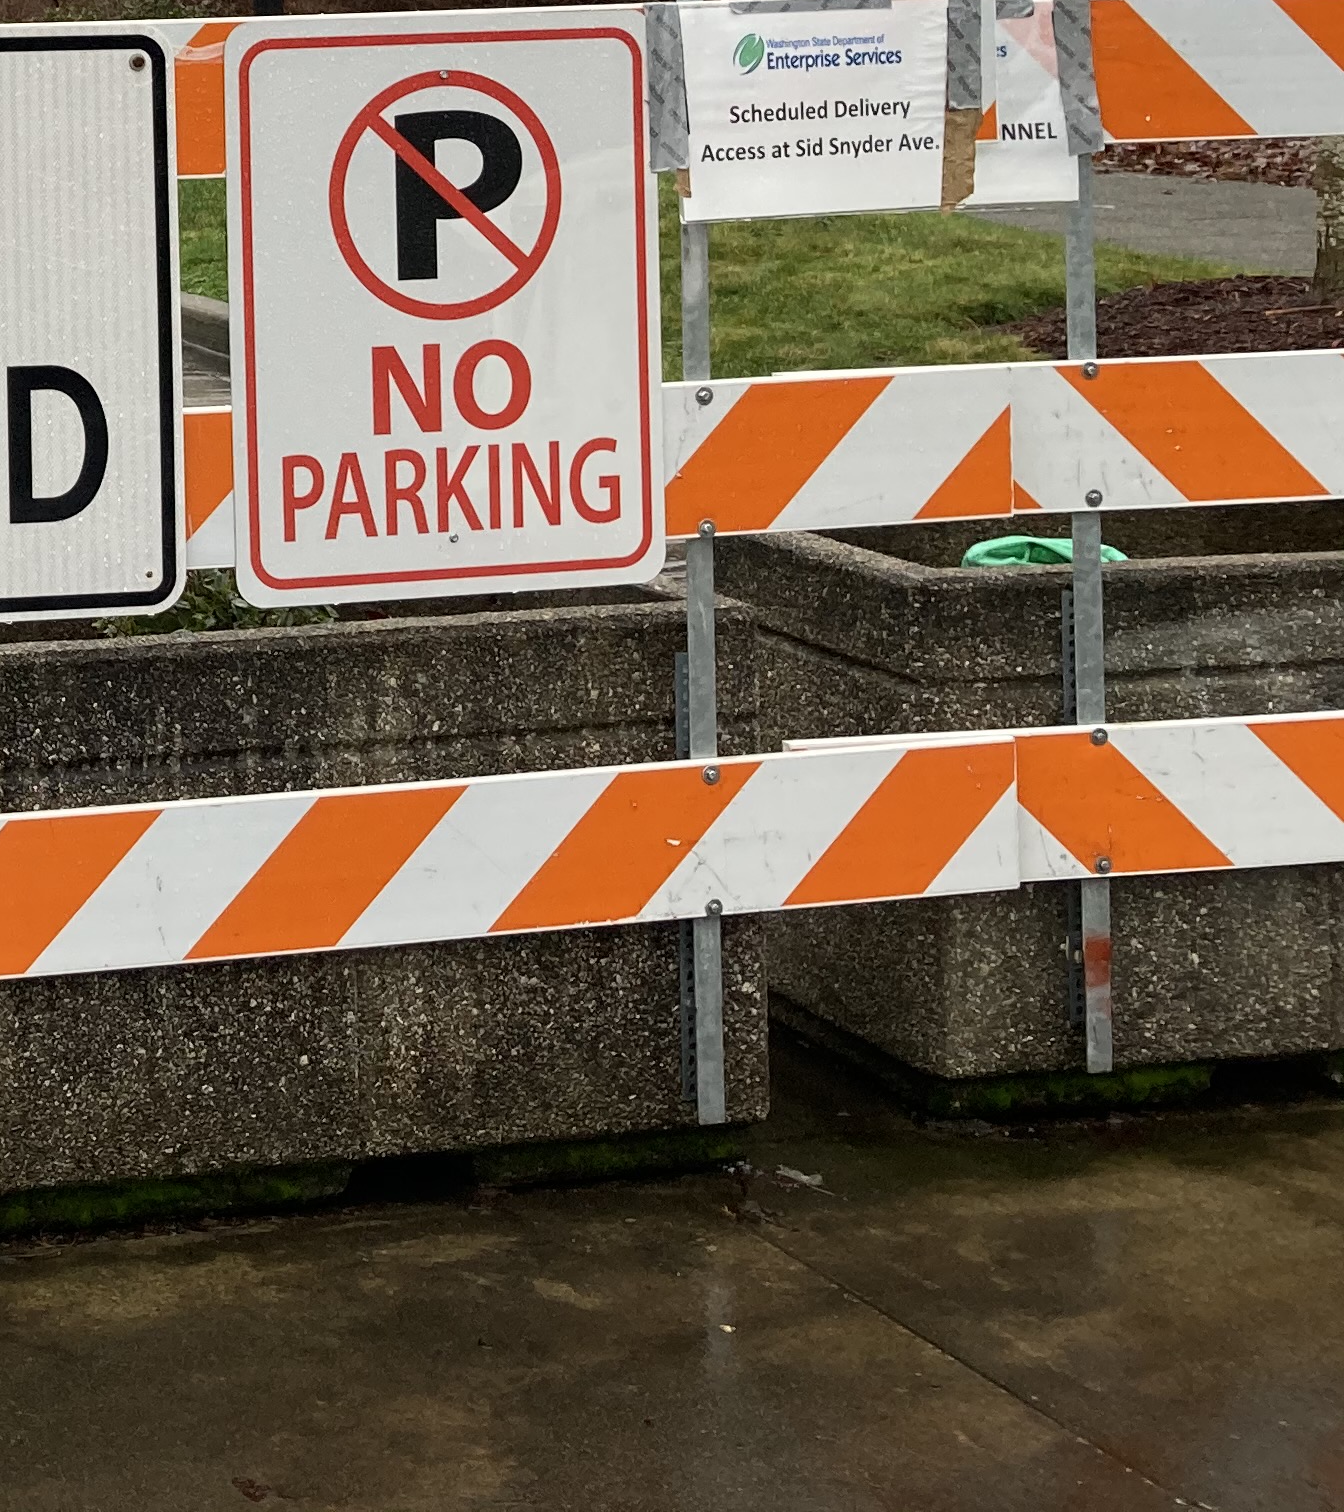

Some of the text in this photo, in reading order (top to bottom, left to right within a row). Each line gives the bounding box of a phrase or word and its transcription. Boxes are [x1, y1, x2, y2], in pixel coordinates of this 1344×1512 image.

[766, 34, 885, 50] Washington State Department of
[767, 47, 902, 72] Enterprise Services
[729, 98, 911, 124] Scheduled Delivery
[701, 133, 940, 163] Access at Sid Snyder Ave.
[371, 338, 532, 436] NO
[282, 437, 622, 543] PARKING
